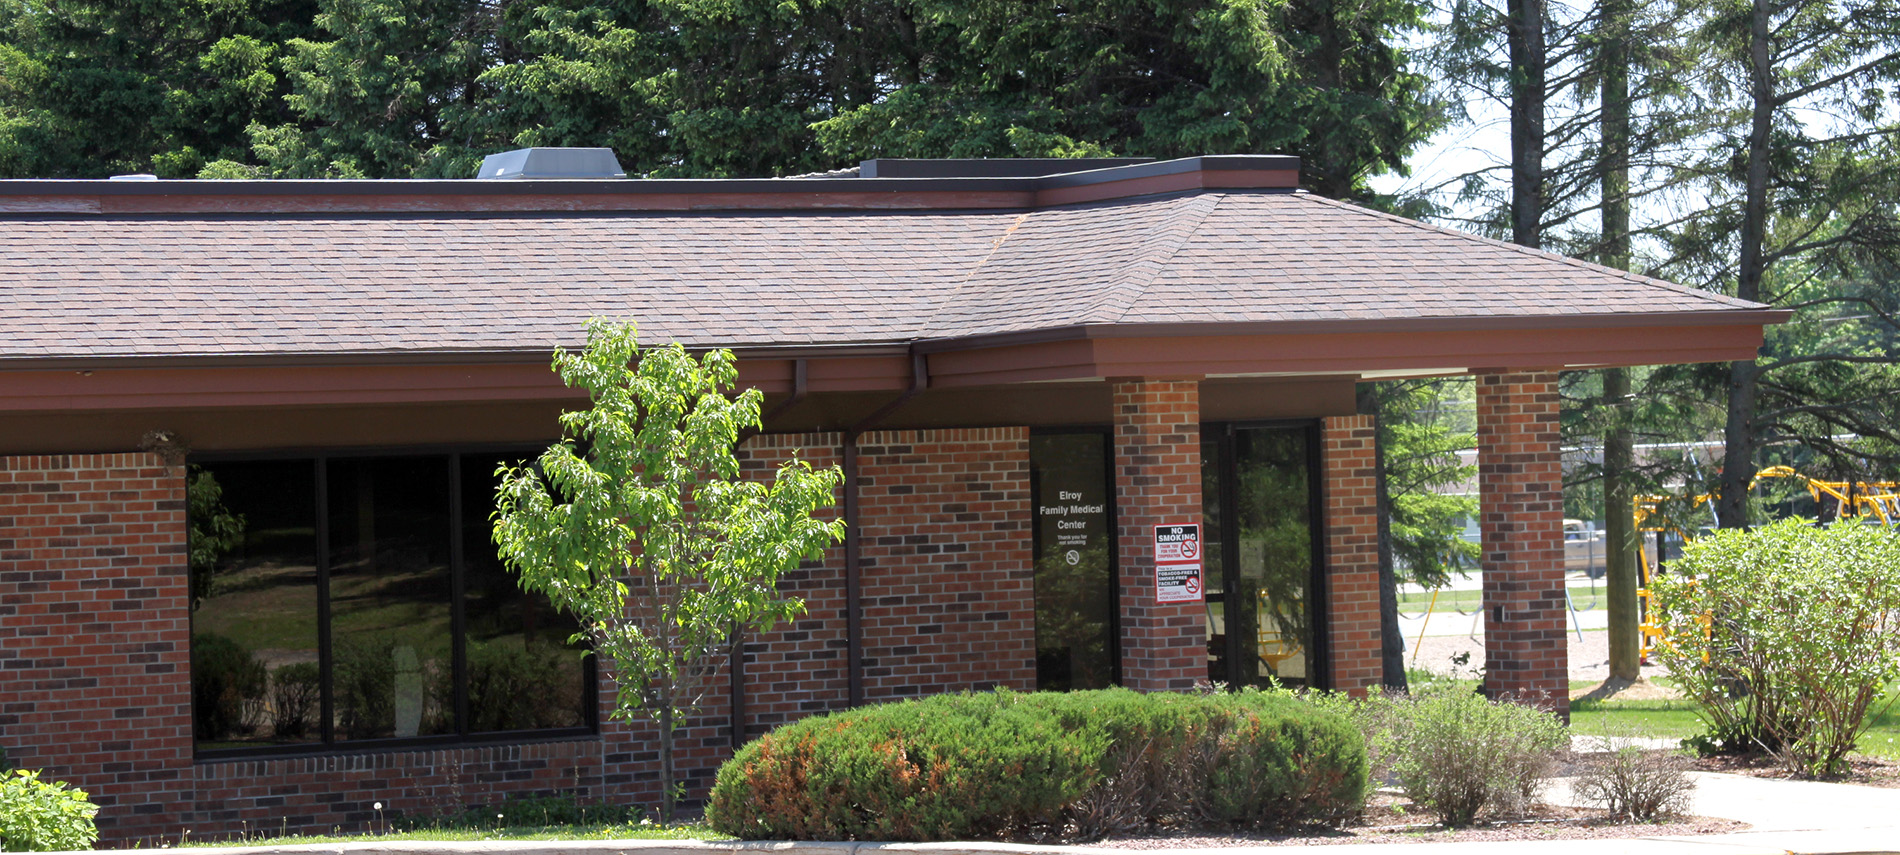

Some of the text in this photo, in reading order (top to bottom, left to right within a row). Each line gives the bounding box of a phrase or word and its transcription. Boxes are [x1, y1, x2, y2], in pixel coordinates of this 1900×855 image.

[1059, 490, 1082, 501] Elroy
[1040, 505, 1103, 516] Family Medical
[1058, 520, 1086, 530] Center
[1158, 534, 1196, 542] SMOKING
